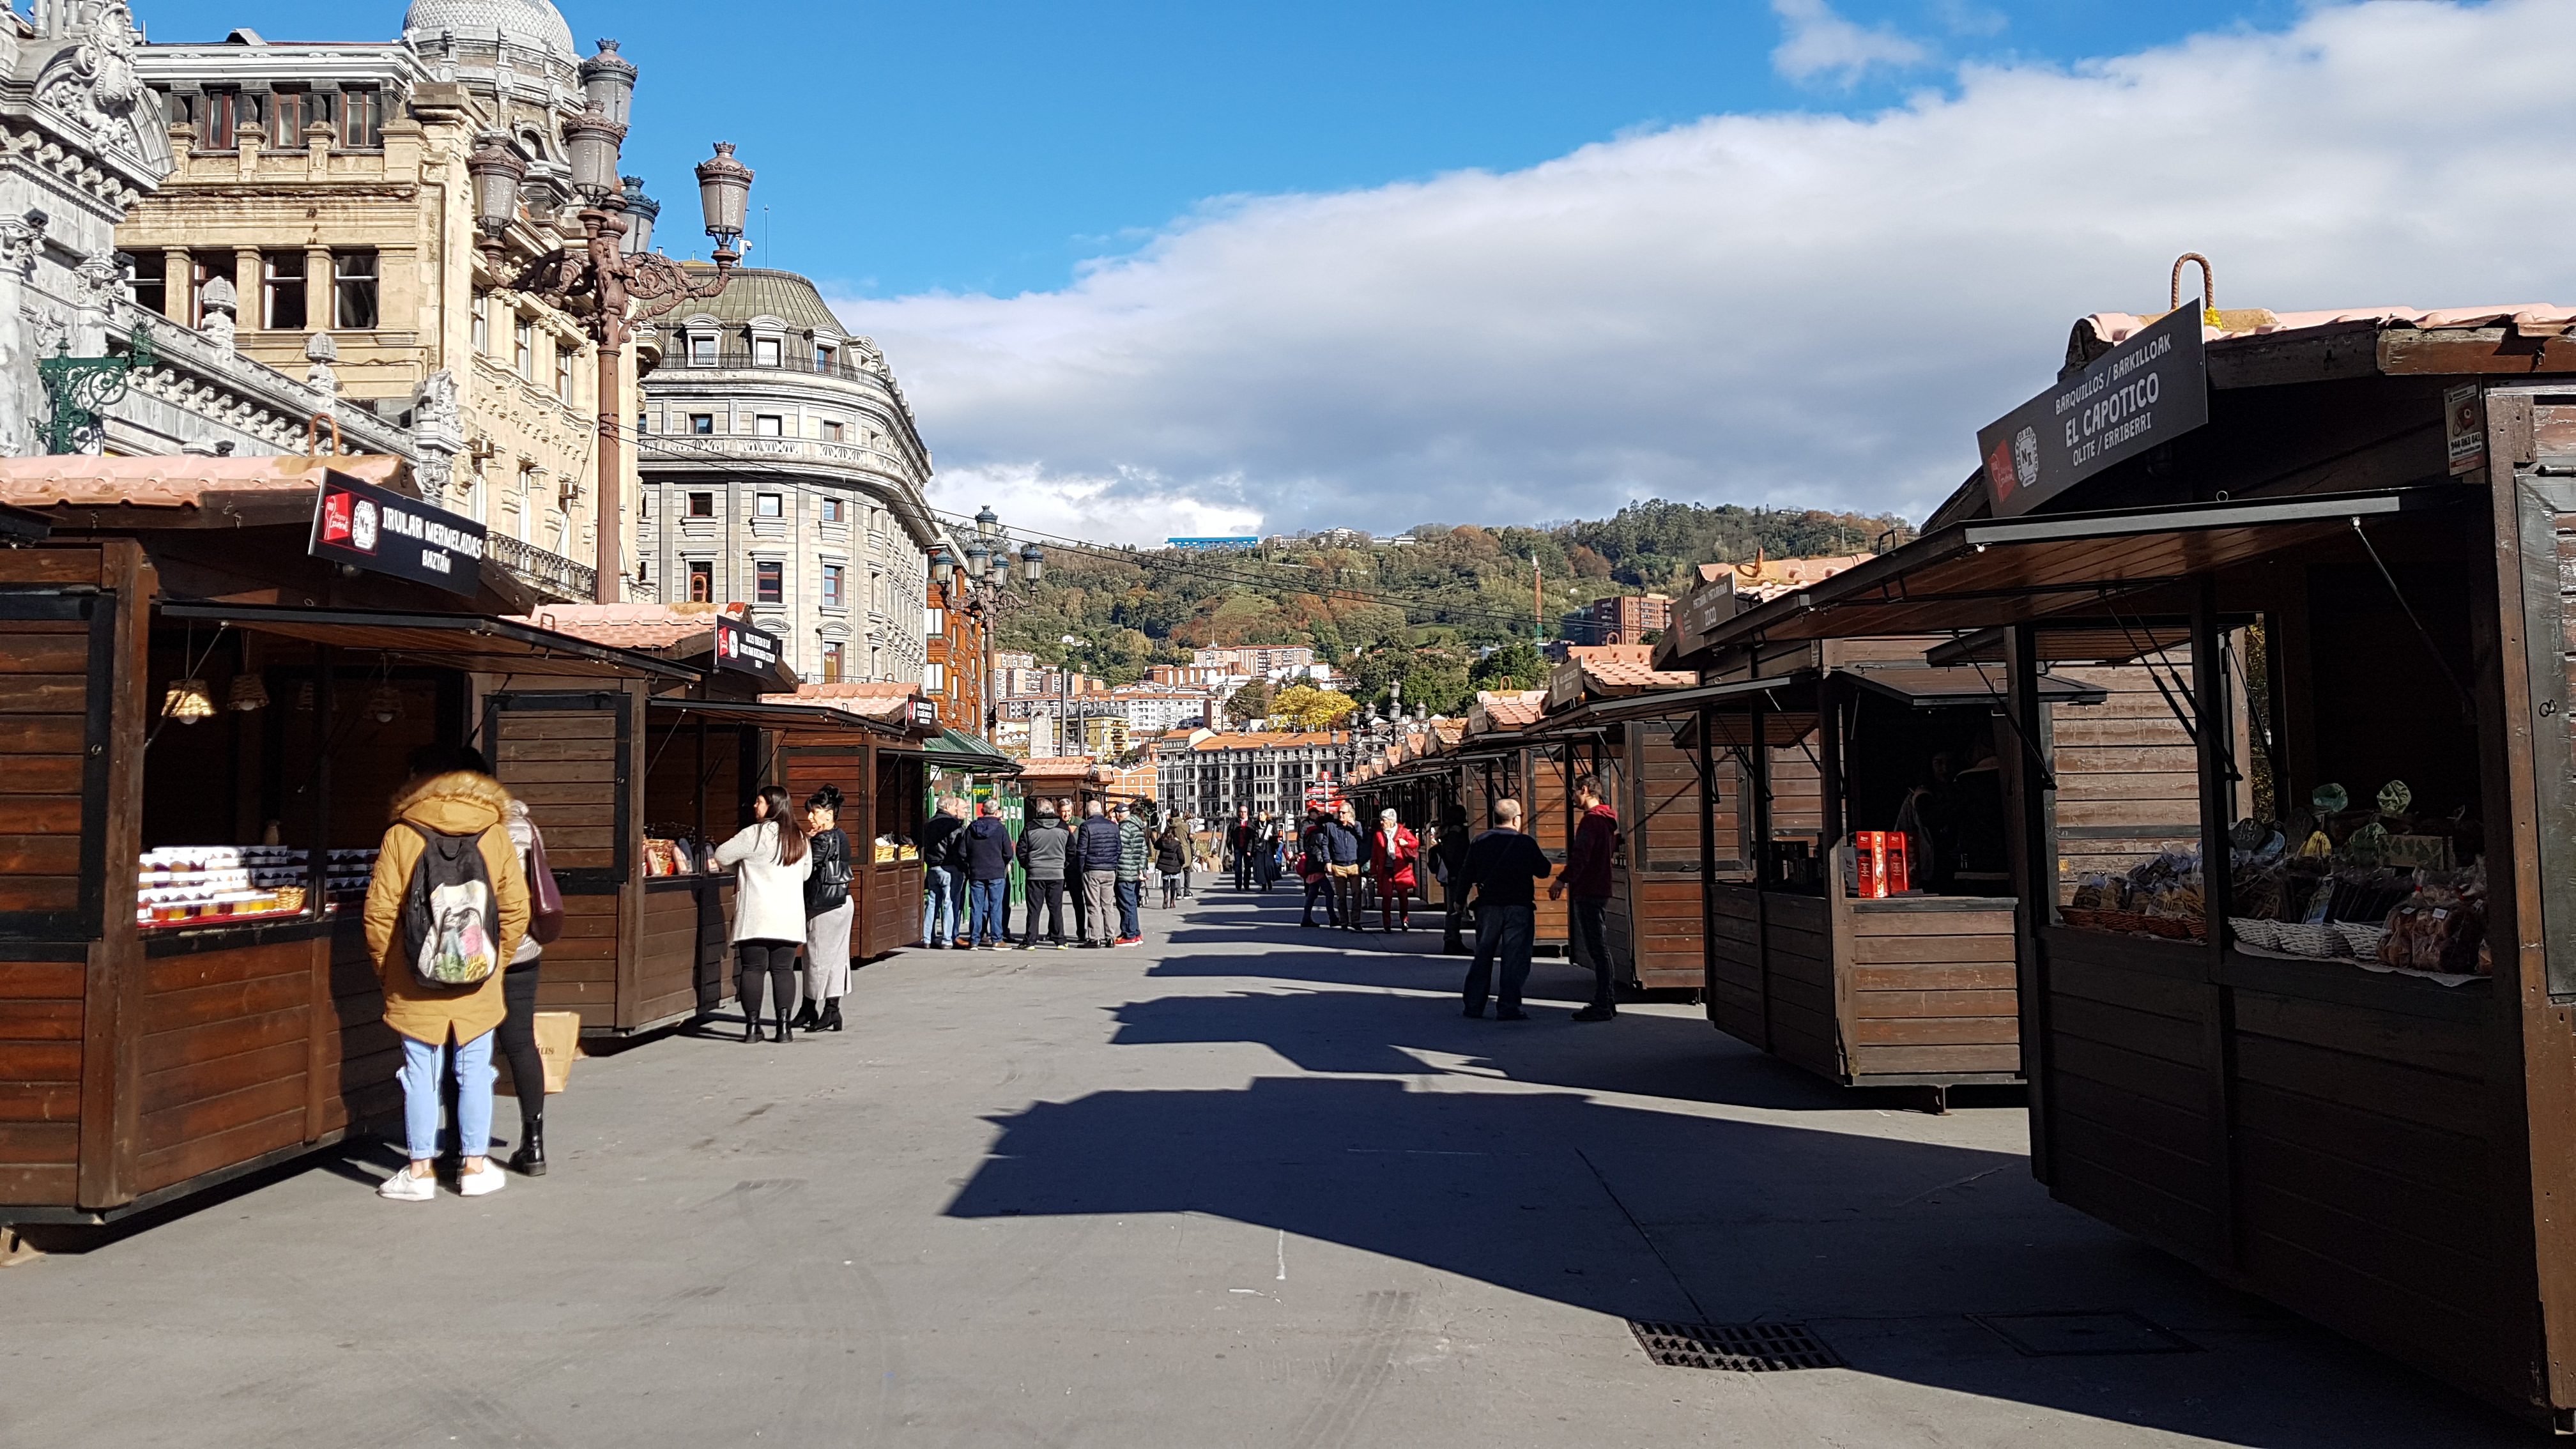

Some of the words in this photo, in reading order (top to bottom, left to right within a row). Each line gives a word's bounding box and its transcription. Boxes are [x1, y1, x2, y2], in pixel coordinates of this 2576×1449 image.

[2055, 373, 2103, 415] BARQUILLOS
[2113, 333, 2171, 381] BARKILLOAK
[2066, 417, 2079, 447] EL
[2083, 372, 2159, 436] CAPOTICO
[2073, 440, 2095, 466] OLITE
[2104, 412, 2151, 450] ERRIBERRI
[383, 507, 423, 538] IRULAR
[425, 521, 482, 559] MERMELADAS
[422, 549, 451, 574] BAZTÁN
